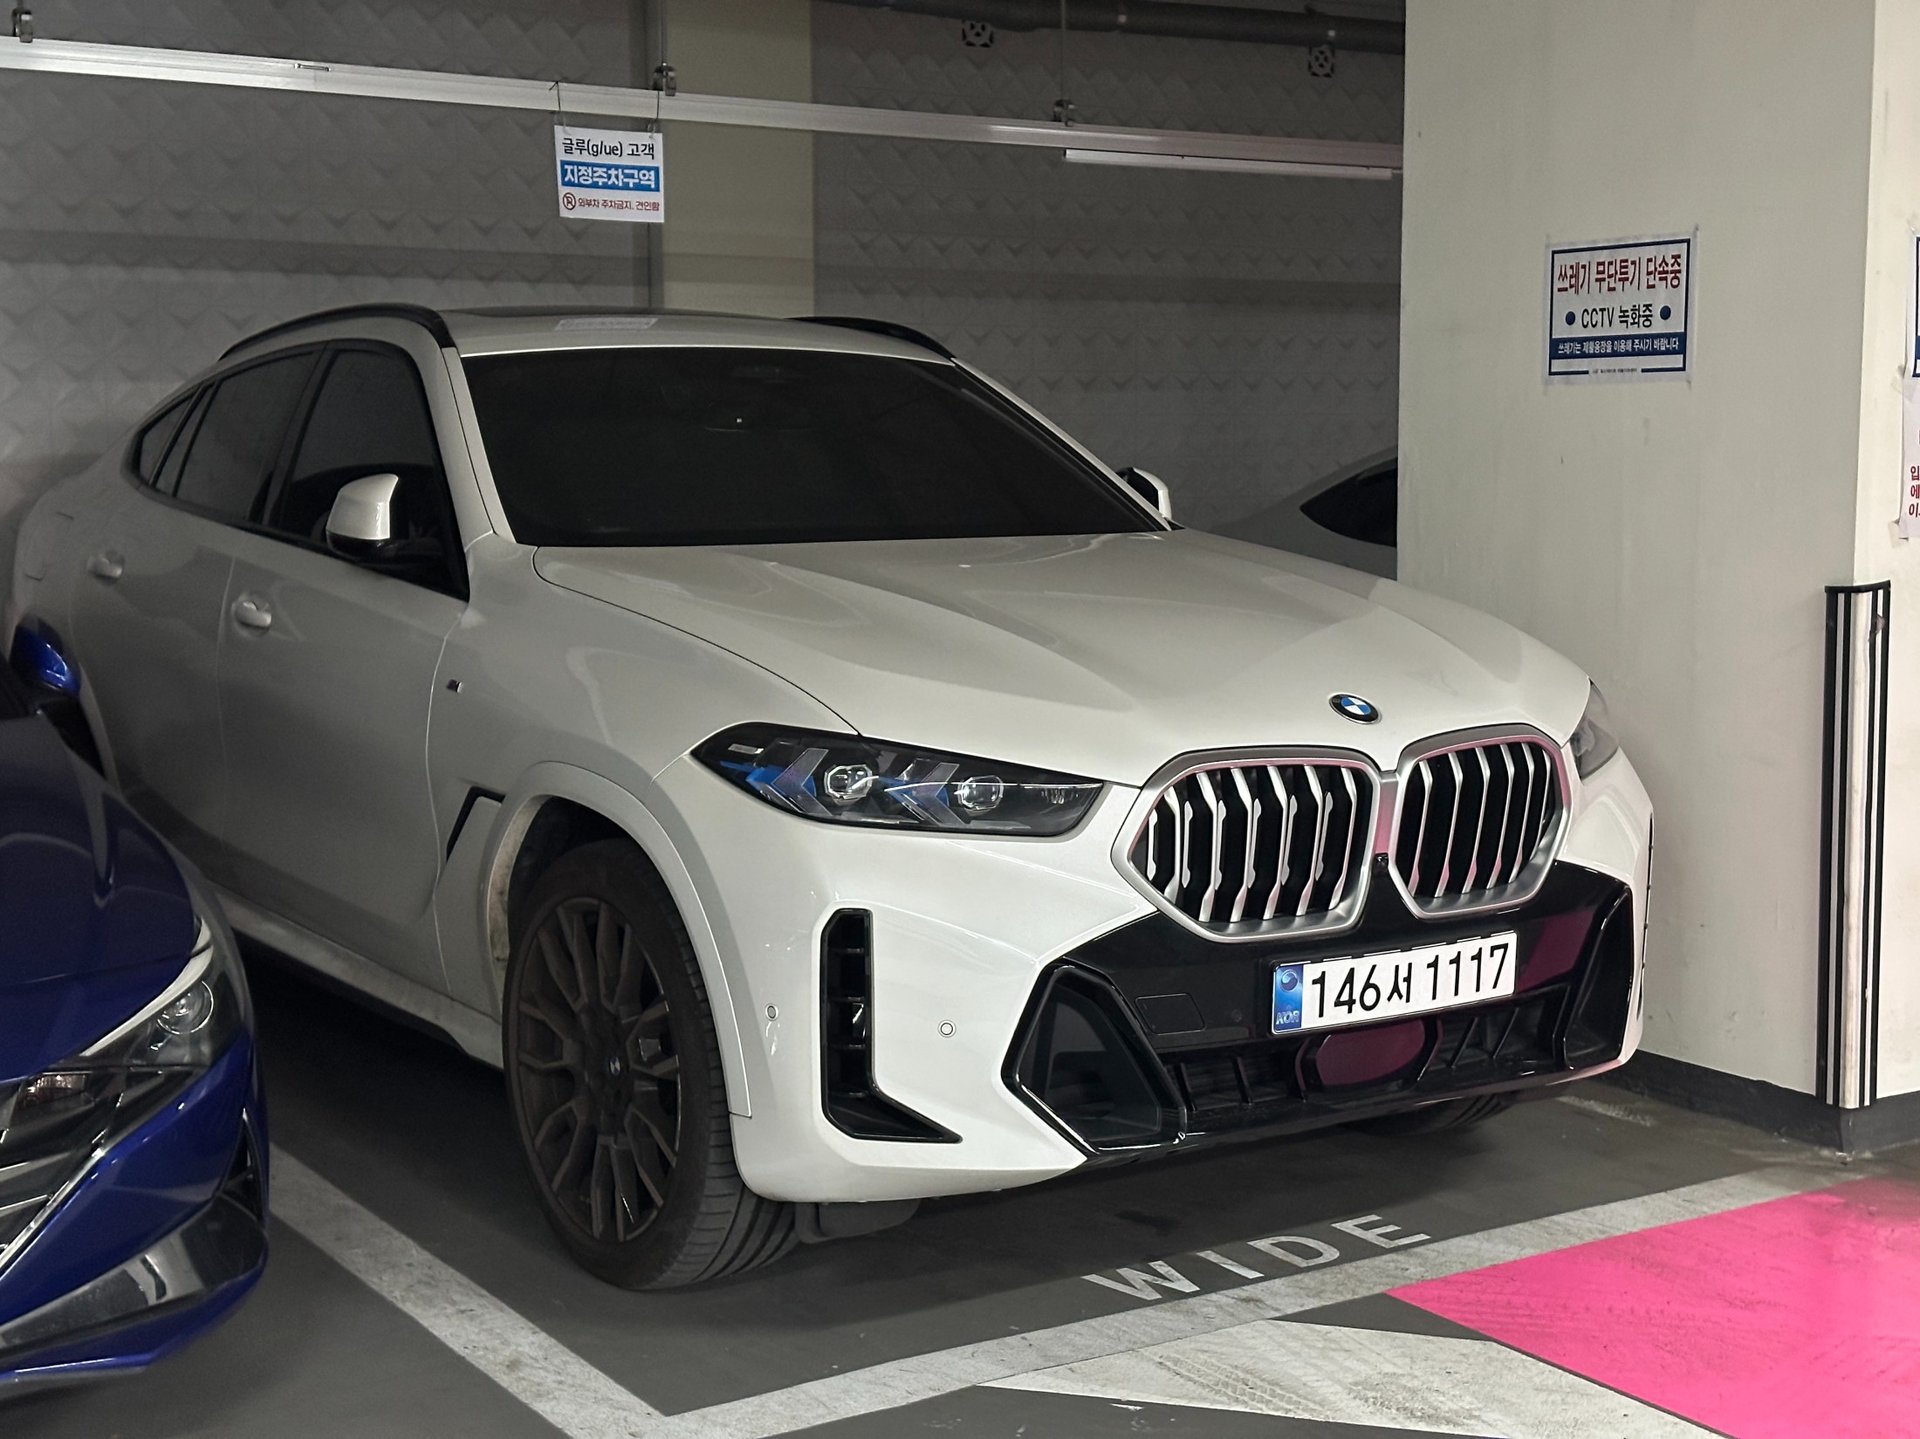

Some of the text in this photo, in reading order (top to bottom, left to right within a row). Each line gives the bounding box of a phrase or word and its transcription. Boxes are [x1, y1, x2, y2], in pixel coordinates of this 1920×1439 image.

[627, 143, 655, 160] 고객
[564, 165, 656, 189] 지정주차구역
[1557, 254, 1682, 295] 쓰레기 무단투기 단속중
[1581, 304, 1653, 329] CCTV 녹화중
[1634, 339, 1652, 351] 주시기
[1653, 338, 1679, 351] 바랍니다
[1312, 943, 1510, 1018] 146서 1117
[1080, 1214, 1432, 1301] WIDE
